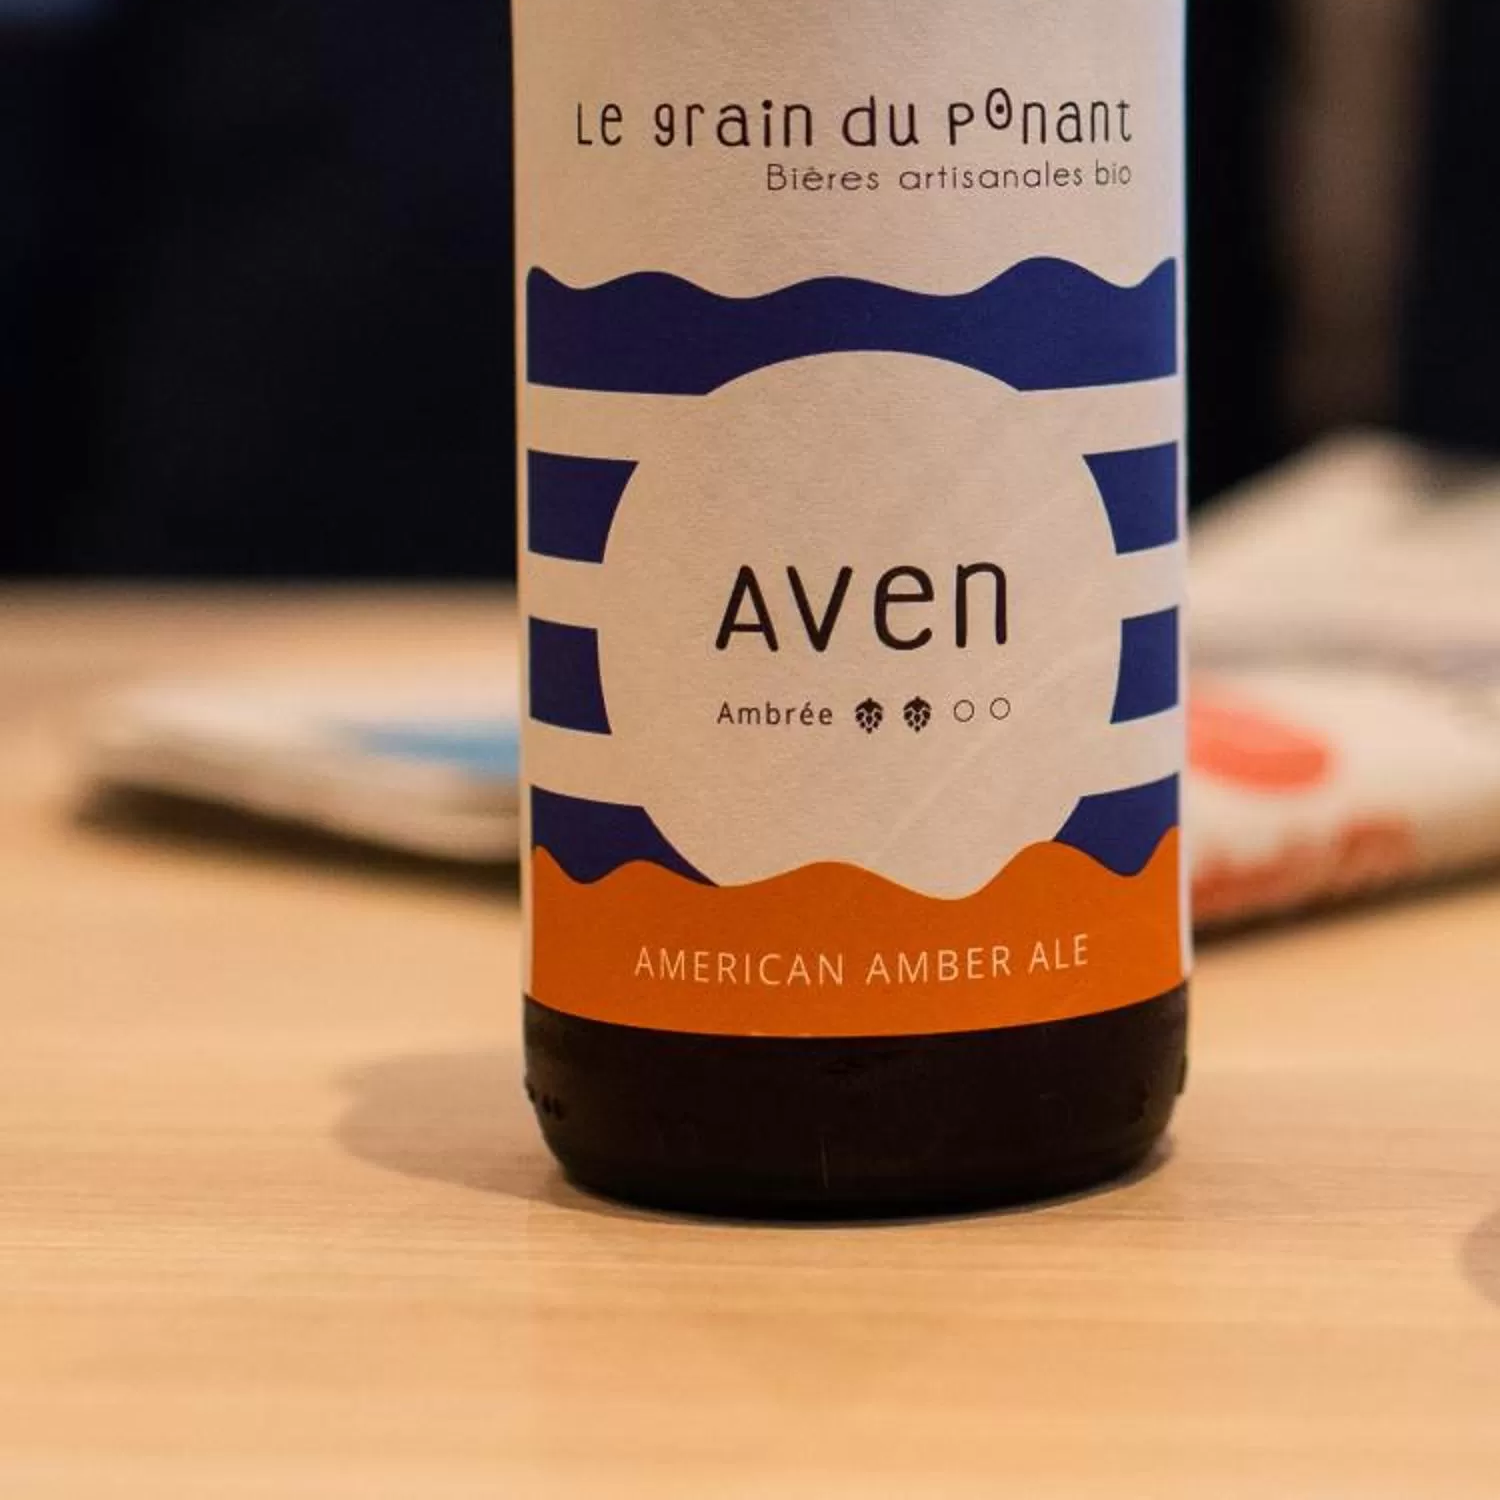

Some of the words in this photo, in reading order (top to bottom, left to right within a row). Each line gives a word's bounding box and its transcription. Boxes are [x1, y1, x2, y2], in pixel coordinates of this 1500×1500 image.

[576, 102, 623, 147] Le
[653, 99, 813, 148] grain
[841, 95, 920, 148] du
[766, 163, 879, 192] Bières
[899, 161, 1083, 190] artisanales
[1095, 159, 1132, 187] bio
[715, 561, 1007, 652] Aven
[717, 700, 833, 726] Ambrée
[634, 946, 844, 986] AMERICAN
[866, 945, 1011, 985] AMBER
[1029, 933, 1088, 973] ALE
